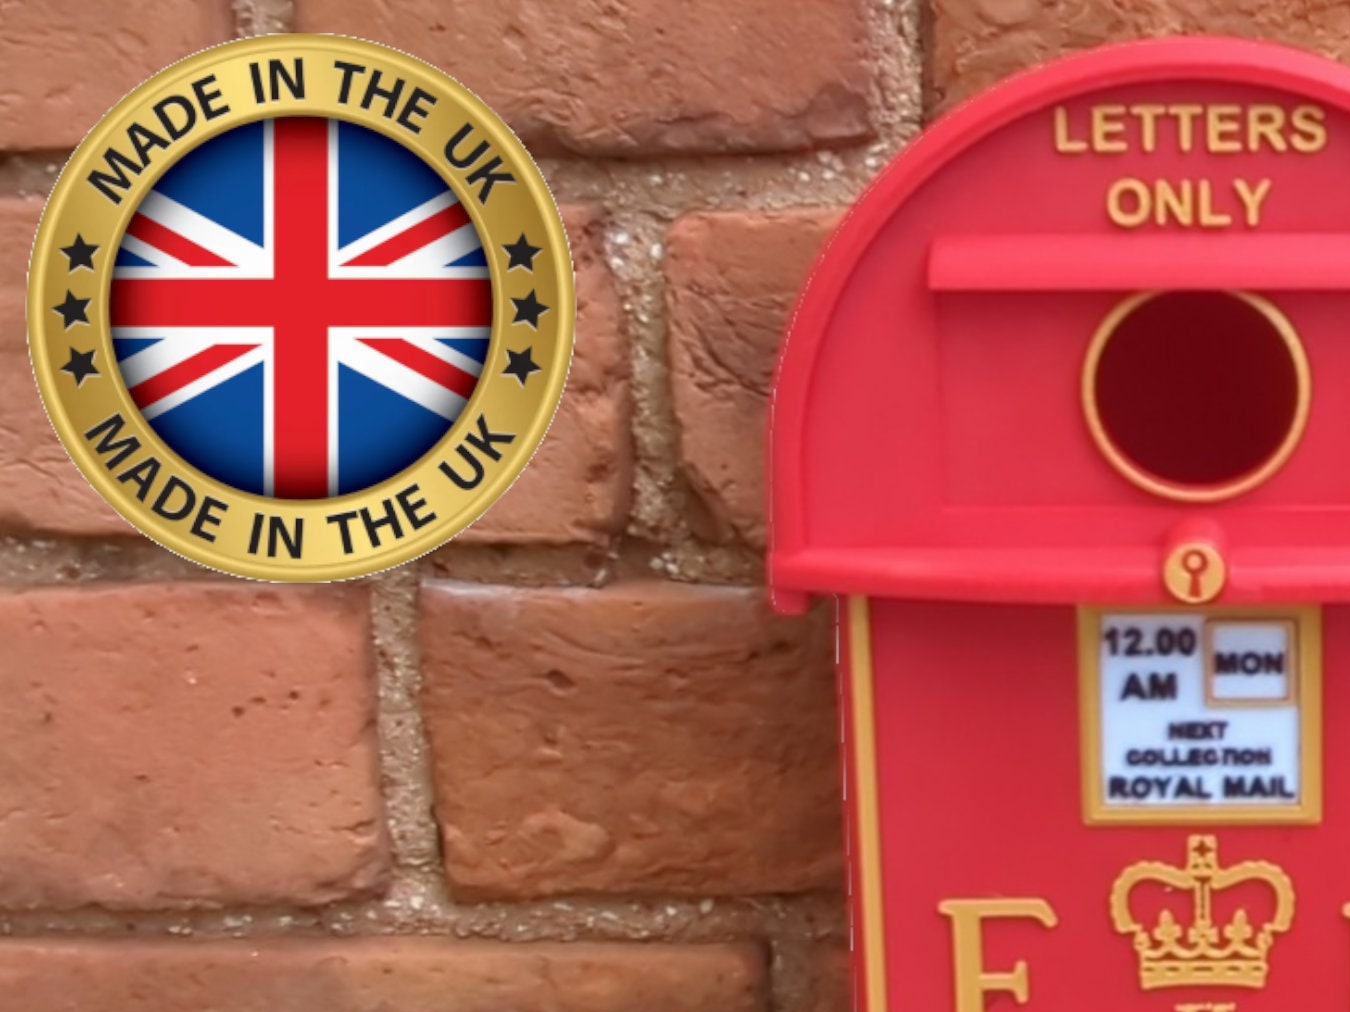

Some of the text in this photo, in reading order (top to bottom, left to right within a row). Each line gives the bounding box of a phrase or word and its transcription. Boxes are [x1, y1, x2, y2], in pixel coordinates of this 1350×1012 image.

[1054, 105, 1327, 152] LETTERS
[1107, 177, 1271, 227] ONLY
[1104, 626, 1196, 657] 12.00
[1215, 652, 1284, 675] MON
[1121, 673, 1177, 700] AM
[1168, 721, 1228, 739] NEXT
[1126, 748, 1272, 766] COLLECTION
[1108, 775, 1295, 799] ROYAL MAIL
